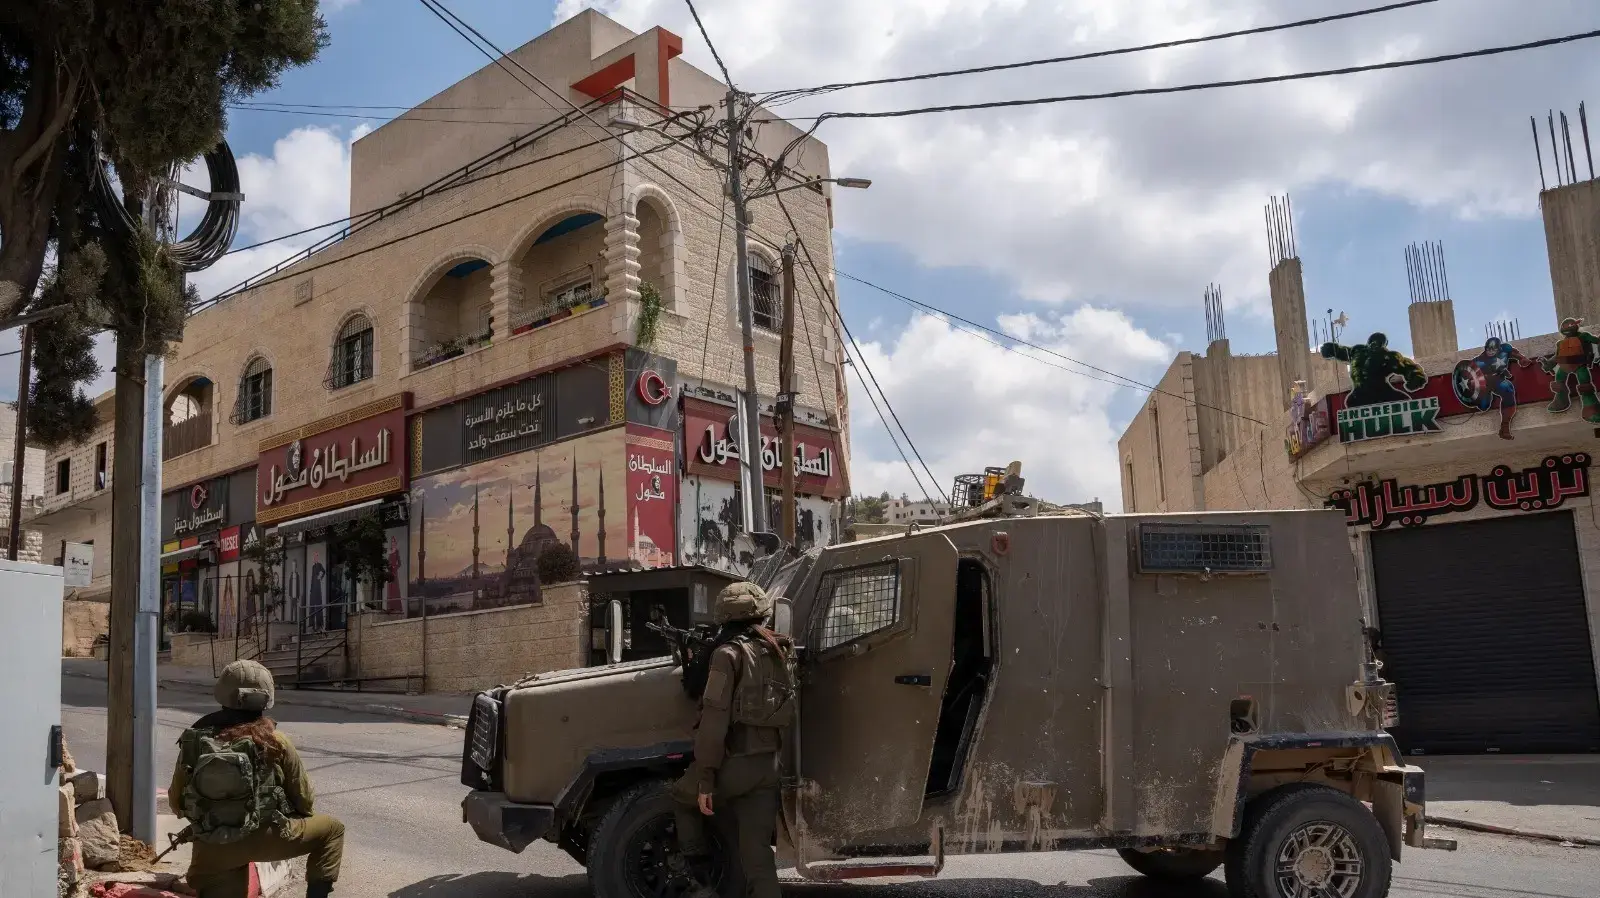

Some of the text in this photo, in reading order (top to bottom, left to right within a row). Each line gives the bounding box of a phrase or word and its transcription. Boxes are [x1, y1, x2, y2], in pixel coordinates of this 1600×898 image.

[496, 402, 514, 423] يلزم
[516, 399, 525, 411] ما
[527, 393, 541, 411] كل
[1343, 398, 1438, 421] INCREDIBLE
[489, 428, 516, 443] سقف
[519, 420, 539, 435] تحت
[1339, 409, 1441, 443] HULK
[701, 424, 739, 465] ول
[263, 428, 391, 506] السلطان مول
[629, 453, 671, 475] السلطان
[636, 482, 665, 501] مول
[1332, 453, 1586, 527] تزين سيارات
[173, 504, 224, 535] إسطنبول جينز
[220, 534, 239, 552] DIESEL
